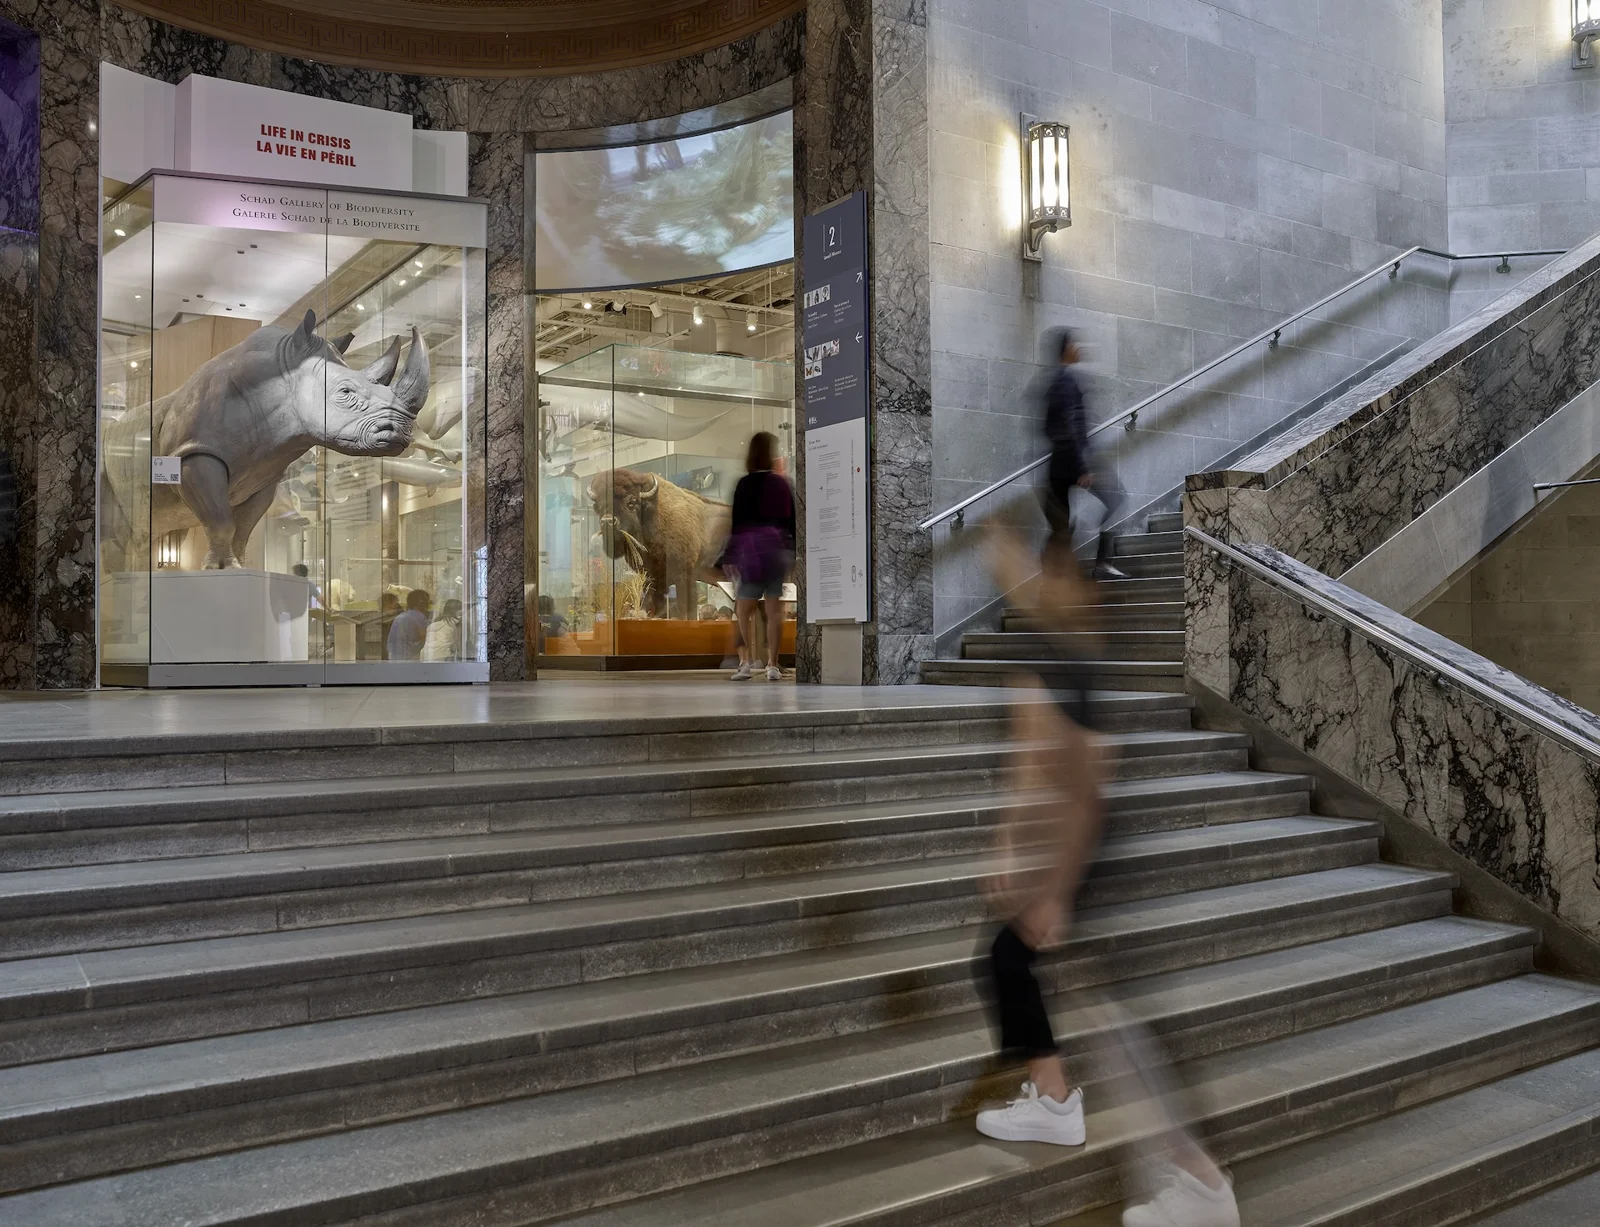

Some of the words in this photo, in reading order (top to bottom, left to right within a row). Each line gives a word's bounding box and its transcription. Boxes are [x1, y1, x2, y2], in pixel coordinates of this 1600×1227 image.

[261, 124, 287, 139] LIFE
[290, 129, 304, 142] IN
[308, 132, 351, 150] CRISIS
[256, 140, 272, 153] LA
[275, 143, 297, 157] VIE
[301, 147, 316, 161] EN
[321, 150, 356, 167] PÉRIL
[829, 226, 836, 246] 2
